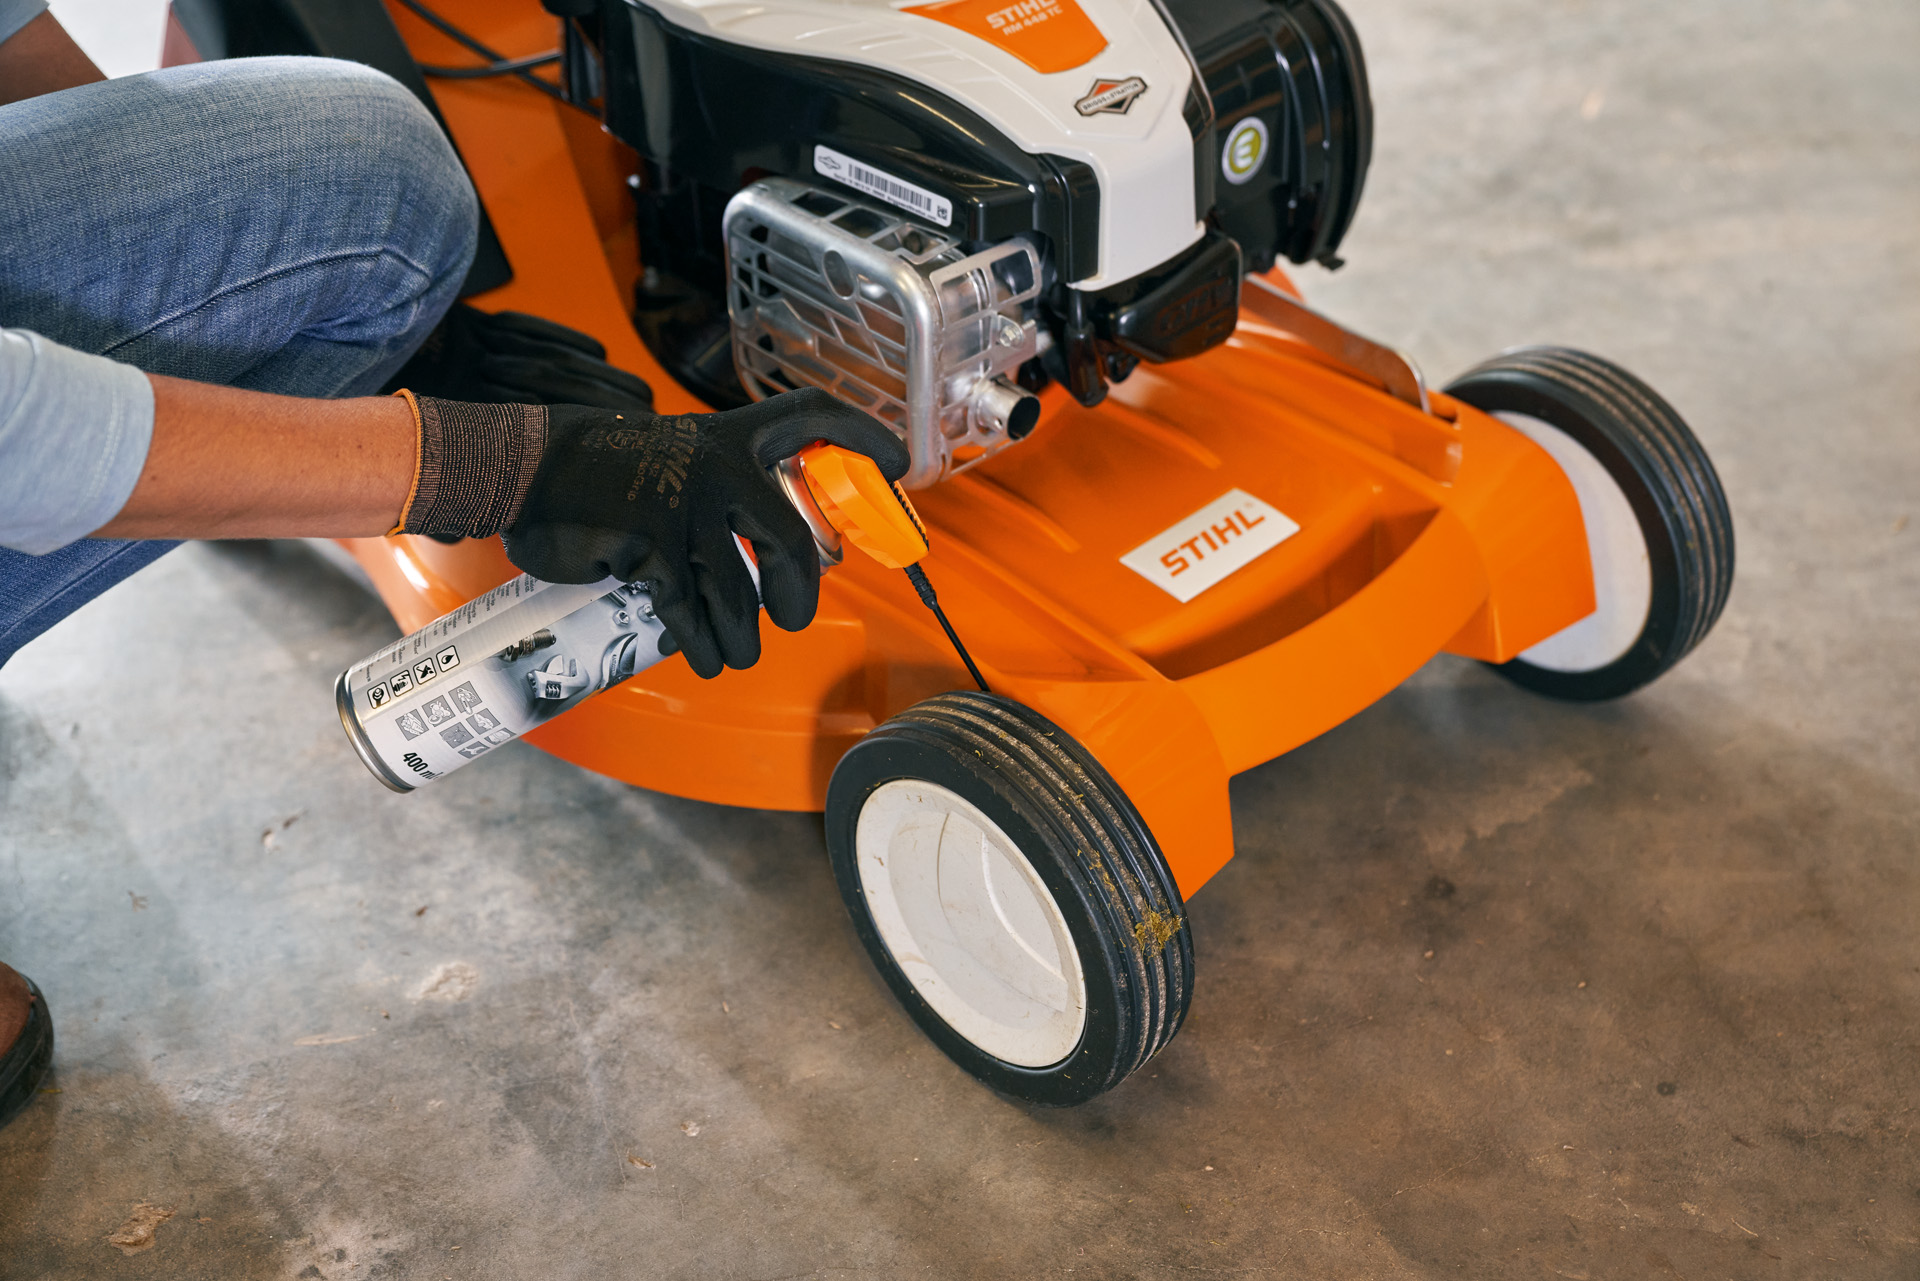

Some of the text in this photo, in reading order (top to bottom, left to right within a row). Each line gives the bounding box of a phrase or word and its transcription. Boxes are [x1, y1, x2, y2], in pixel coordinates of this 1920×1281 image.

[985, 0, 1058, 29] STIHL
[1160, 509, 1266, 577] STIHL
[402, 751, 428, 773] 400
